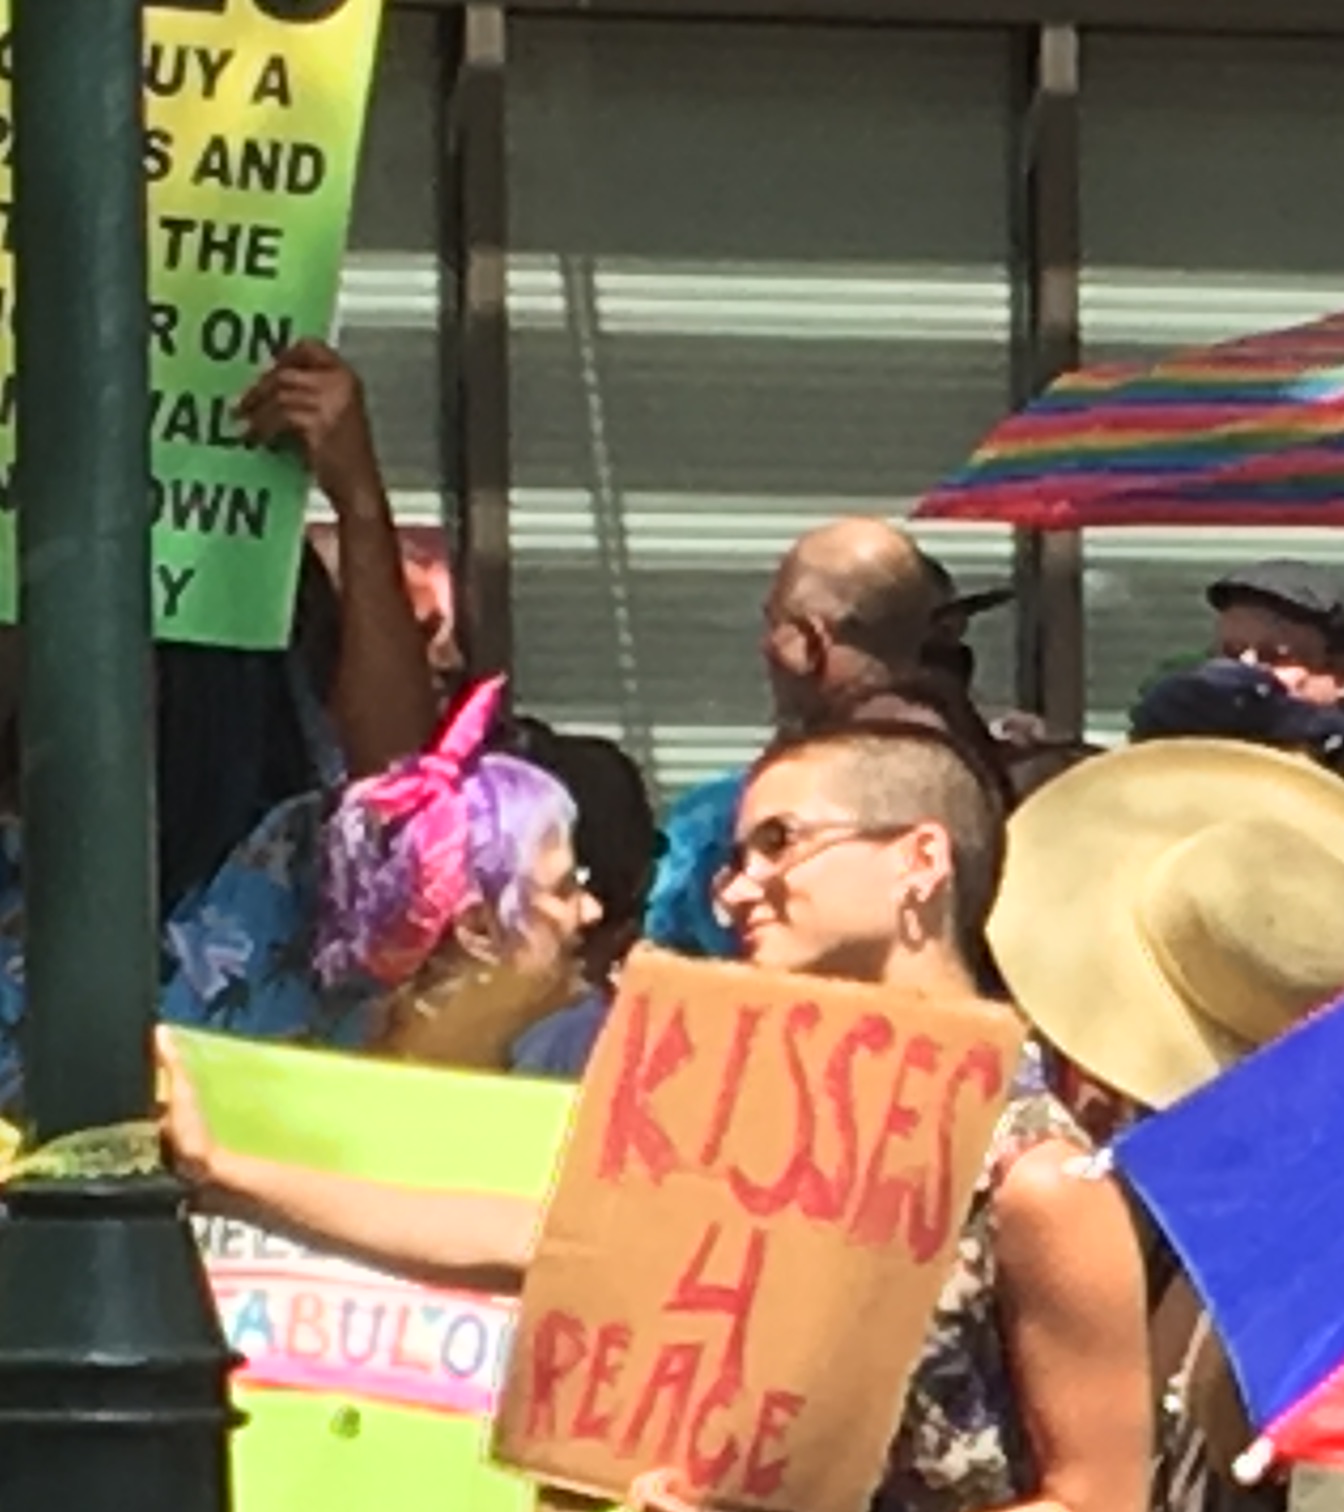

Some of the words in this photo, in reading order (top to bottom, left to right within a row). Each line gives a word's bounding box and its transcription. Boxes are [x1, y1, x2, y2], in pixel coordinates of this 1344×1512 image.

[147, 44, 235, 102] UY
[250, 54, 292, 108] A
[190, 135, 327, 196] AND
[158, 216, 284, 279] THE
[201, 308, 293, 366] ON
[598, 993, 1003, 1266] KISSES
[214, 1287, 506, 1379] ABULO
[662, 1221, 767, 1394] 4
[525, 1308, 807, 1498] PEACE
